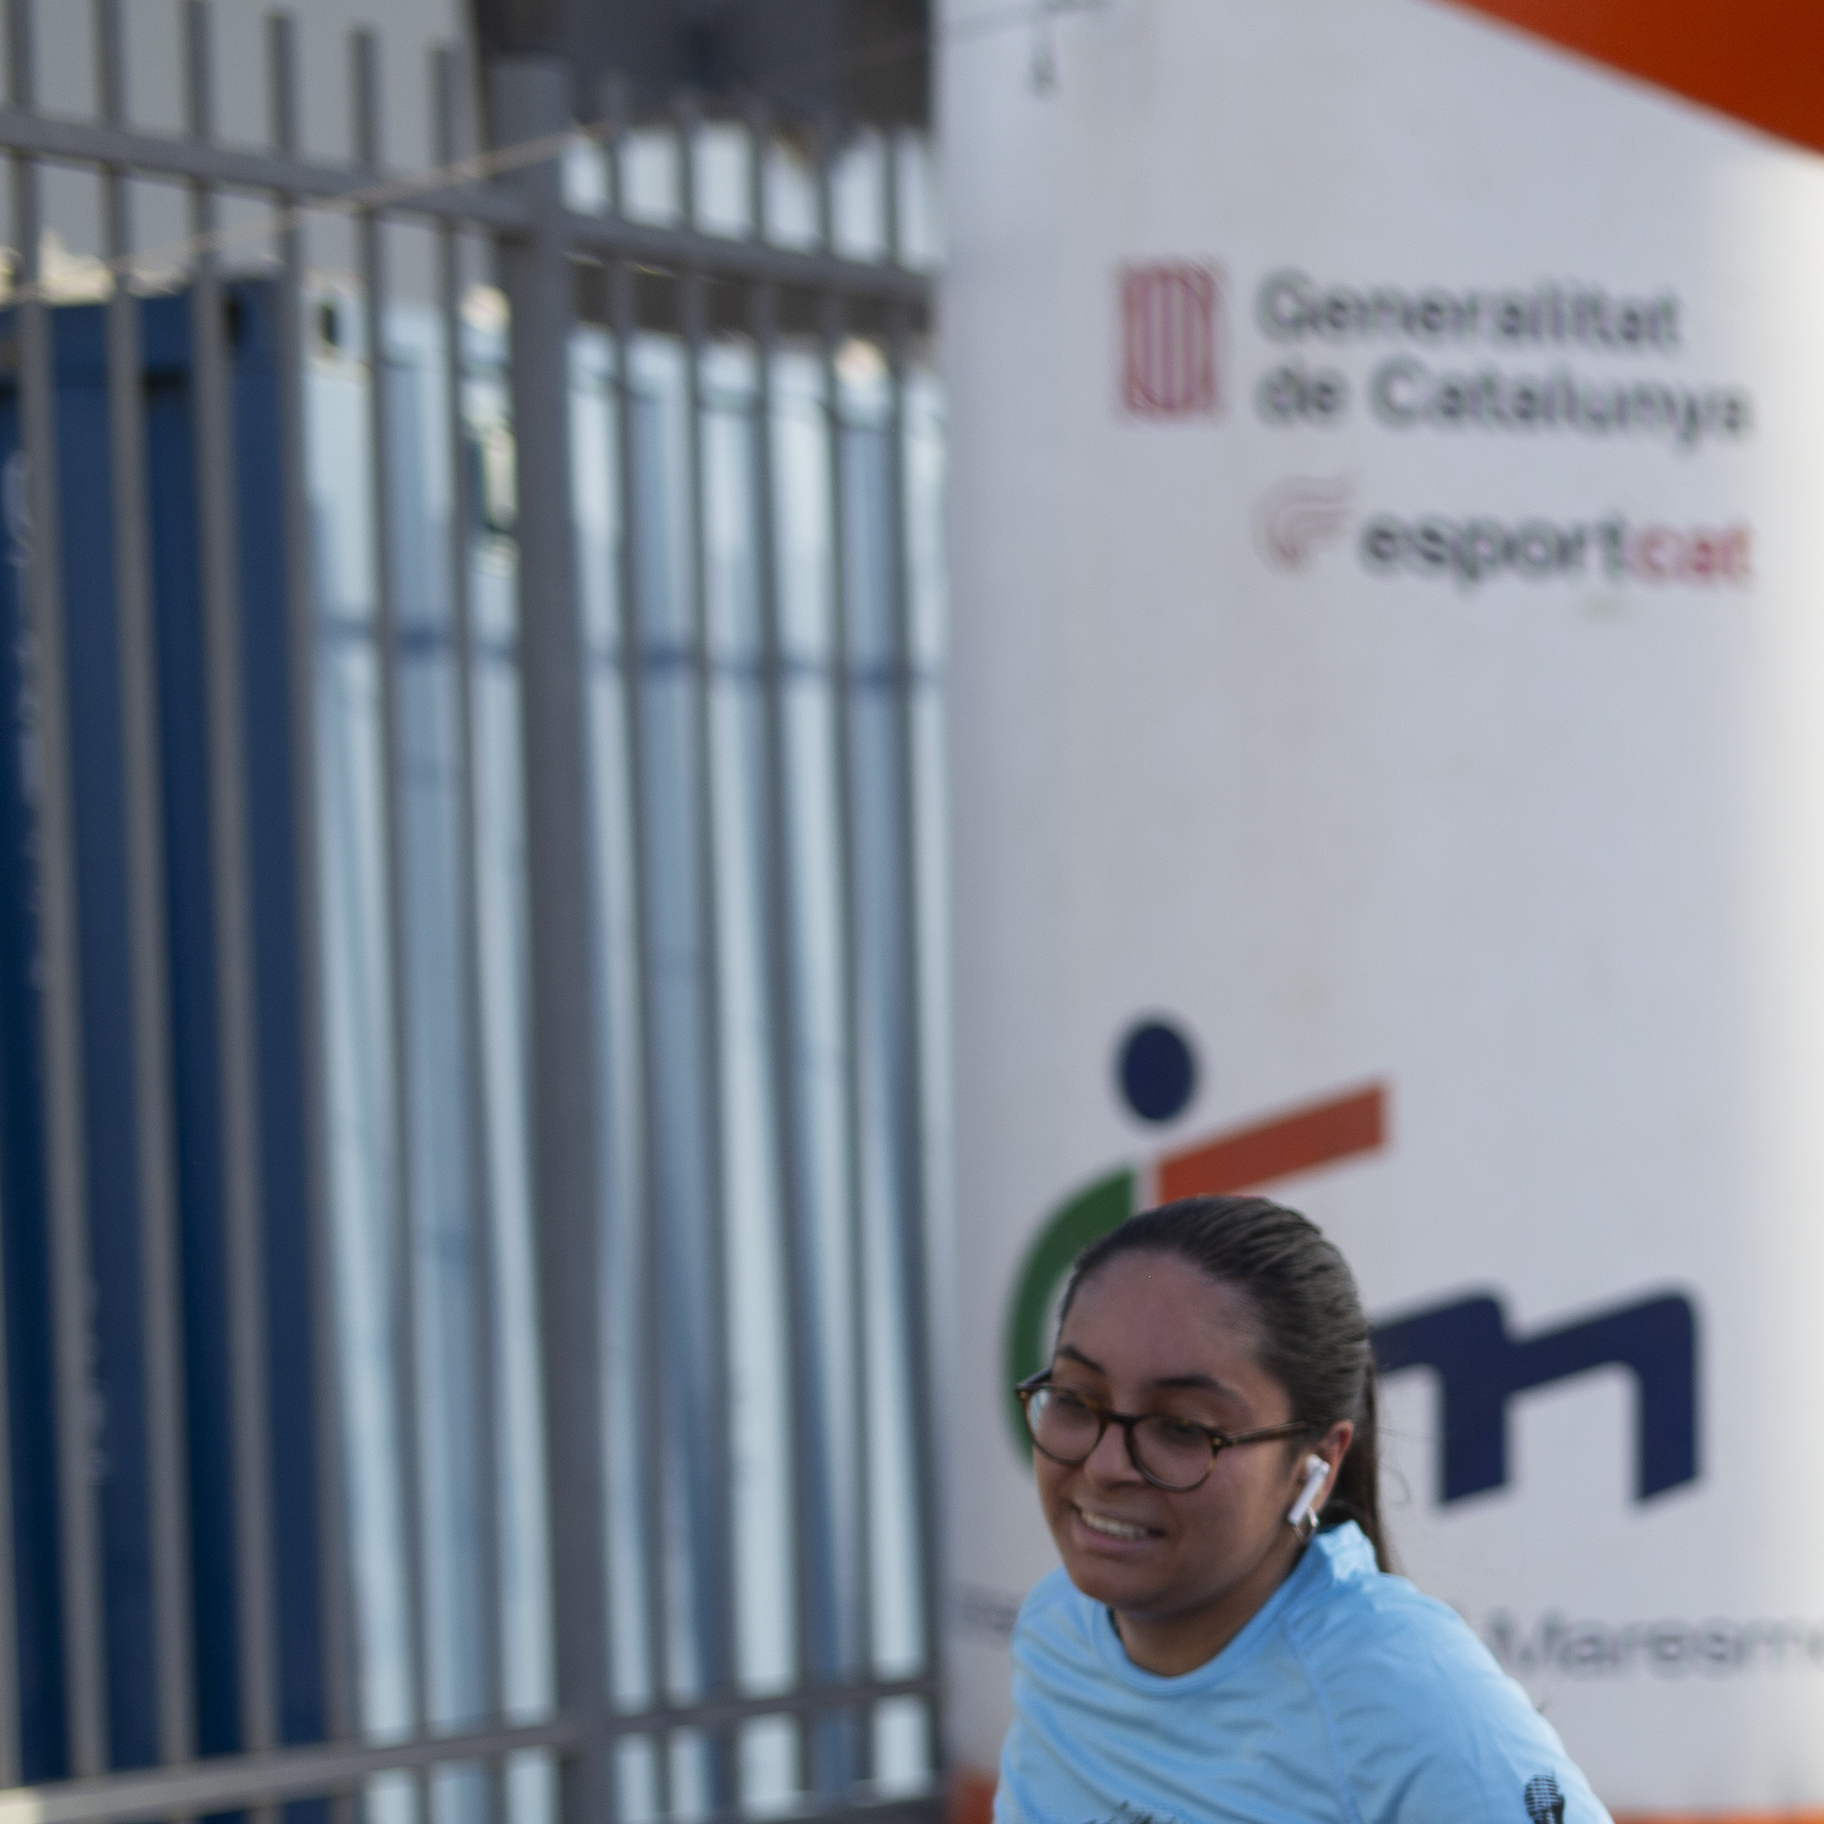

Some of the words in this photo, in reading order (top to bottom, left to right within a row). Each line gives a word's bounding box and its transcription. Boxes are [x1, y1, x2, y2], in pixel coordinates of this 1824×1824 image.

[1257, 268, 1684, 350] Generalitat
[1257, 360, 1347, 428] de
[1371, 358, 1753, 452] Catalunya
[1360, 510, 1752, 594] esportcat
